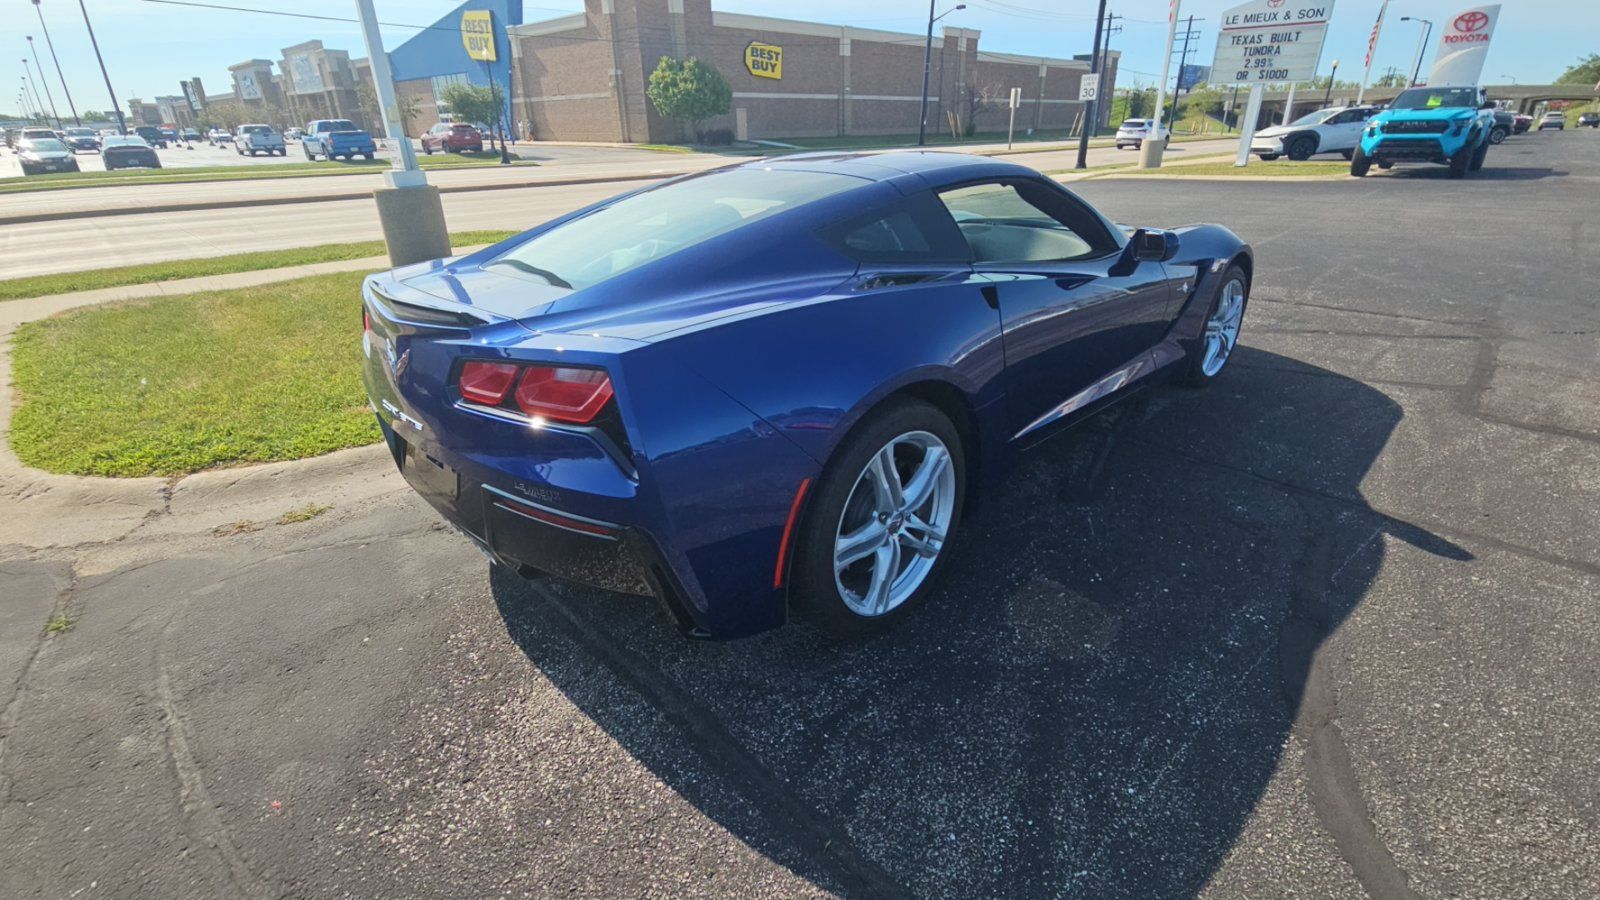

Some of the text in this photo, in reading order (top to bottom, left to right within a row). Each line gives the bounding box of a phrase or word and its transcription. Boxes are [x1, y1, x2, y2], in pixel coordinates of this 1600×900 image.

[1226, 8, 1324, 25] LE MIEUX & SON
[464, 19, 490, 34] BEST
[468, 36, 489, 51] BUY
[1231, 32, 1301, 45] TEXAS BUILT
[1444, 34, 1488, 43] TOYOTA
[751, 47, 781, 62] BEST
[1243, 46, 1280, 56] TUNDRA
[752, 59, 777, 73] BUY
[1244, 58, 1274, 68] 2.99%
[1236, 71, 1248, 80] OR
[1082, 88, 1095, 97] 30
